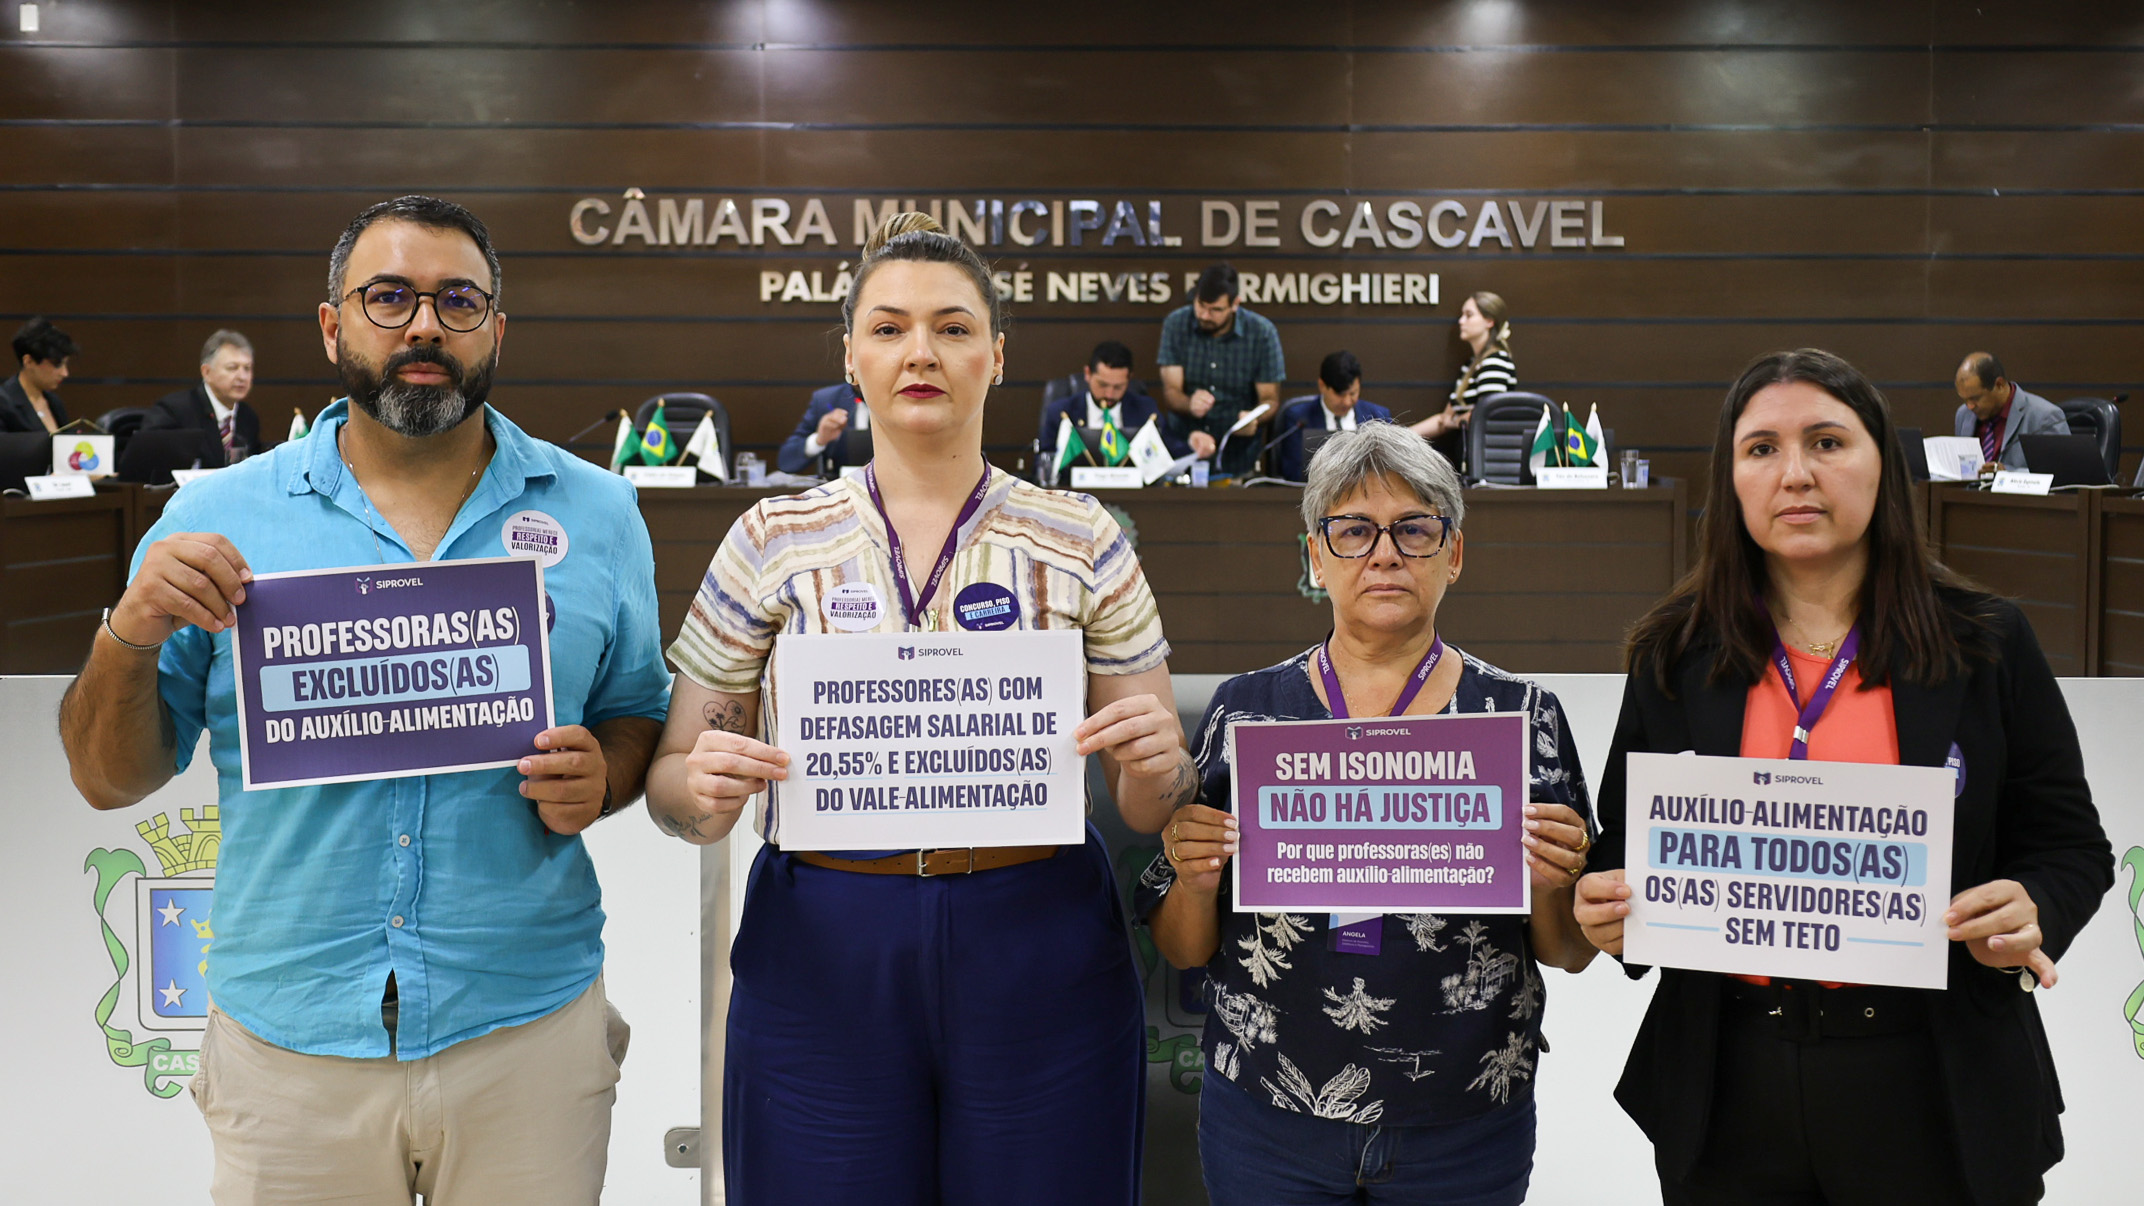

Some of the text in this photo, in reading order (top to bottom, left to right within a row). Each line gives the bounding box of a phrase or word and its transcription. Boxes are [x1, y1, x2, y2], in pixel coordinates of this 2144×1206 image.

[570, 187, 838, 245] CÂMARA
[1201, 200, 1281, 247] DE
[1300, 200, 1625, 248] CASCAVEL
[759, 261, 1440, 305] PALÁ SÉ NEVES FRMIGHIERI
[511, 541, 558, 556] VALORIZAÇÃO
[516, 532, 554, 545] RESPEITO E
[375, 577, 424, 590] SIPROVEL
[931, 555, 949, 587] SIPROVEL
[830, 610, 877, 621] VALORIZAÇÃO
[959, 596, 1011, 613] CONCURSO, PISO
[974, 606, 1006, 618] CARREIRA
[262, 605, 520, 660] PROFESSORAS(AS)
[918, 647, 964, 657] SIPROVEL
[1417, 652, 1439, 681] SIPROVEL
[291, 652, 501, 703] EXCLUÍDOS(AS)
[1824, 658, 1850, 690] SIPROVEL
[813, 676, 1043, 707] PROFESSORES(AS) COM
[265, 695, 535, 744] DO AUXÍLIO-ALIMENTAÇÃO
[800, 711, 1058, 741] DEFASAGEM SALARIAL DE
[1365, 727, 1411, 737] SIPROVEL
[805, 745, 1053, 780] 20,55% E EXCLUÍDOS(AS)
[1275, 751, 1477, 781] SEM ISONOMIA
[1775, 774, 1824, 786] SIPROVEL
[815, 779, 1048, 812] DO VALE-ALIMENTAÇÃO
[1270, 788, 1491, 828] NÃO HÁ JUSTIÇA
[1649, 793, 1928, 839] AUXÍLIO-ALIMENTAÇÃO
[1277, 841, 1485, 864] Por que professoras(es) não
[1659, 831, 1909, 888] PARA TODOS(AS)
[1267, 865, 1495, 887] recebem auxílio-alimentação?
[1645, 875, 1927, 928] OS(AS) SERVIDORES(AS)
[1342, 930, 1366, 938] ANGELA
[1725, 917, 1841, 952] SEM TETO
[152, 1054, 200, 1072] CAS
